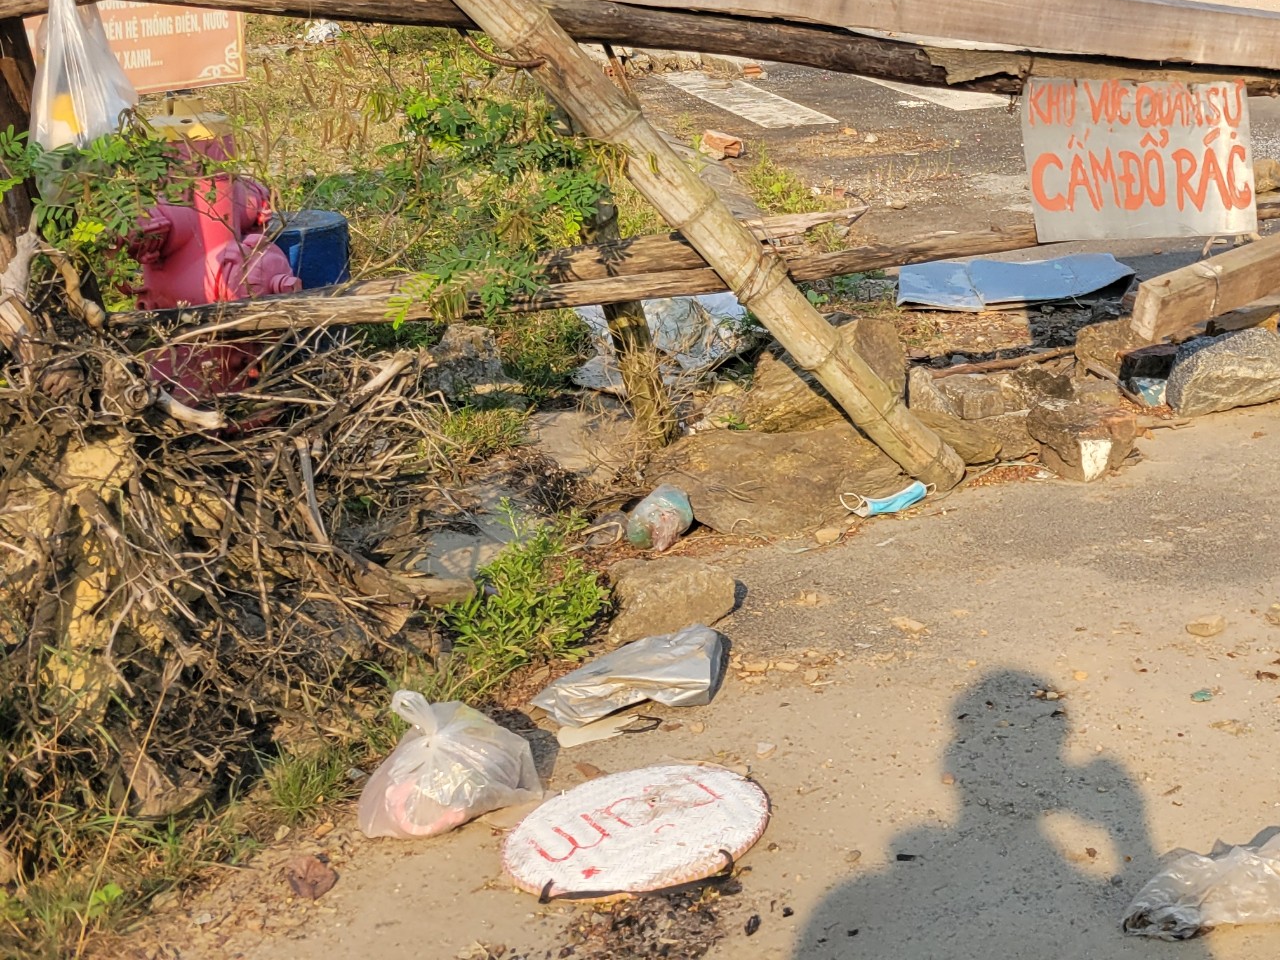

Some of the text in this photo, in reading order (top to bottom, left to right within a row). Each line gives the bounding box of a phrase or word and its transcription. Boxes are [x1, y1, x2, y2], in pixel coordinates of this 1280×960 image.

[125, 15, 139, 42] HỆ
[140, 11, 174, 37] THỐNG
[174, 10, 201, 37] ĐIỆN,
[1028, 82, 1077, 127] KHU
[1083, 79, 1132, 132] VỰC
[1135, 80, 1203, 128] QUÂN
[1031, 127, 1252, 212] CẤM ĐỔ RÁC
